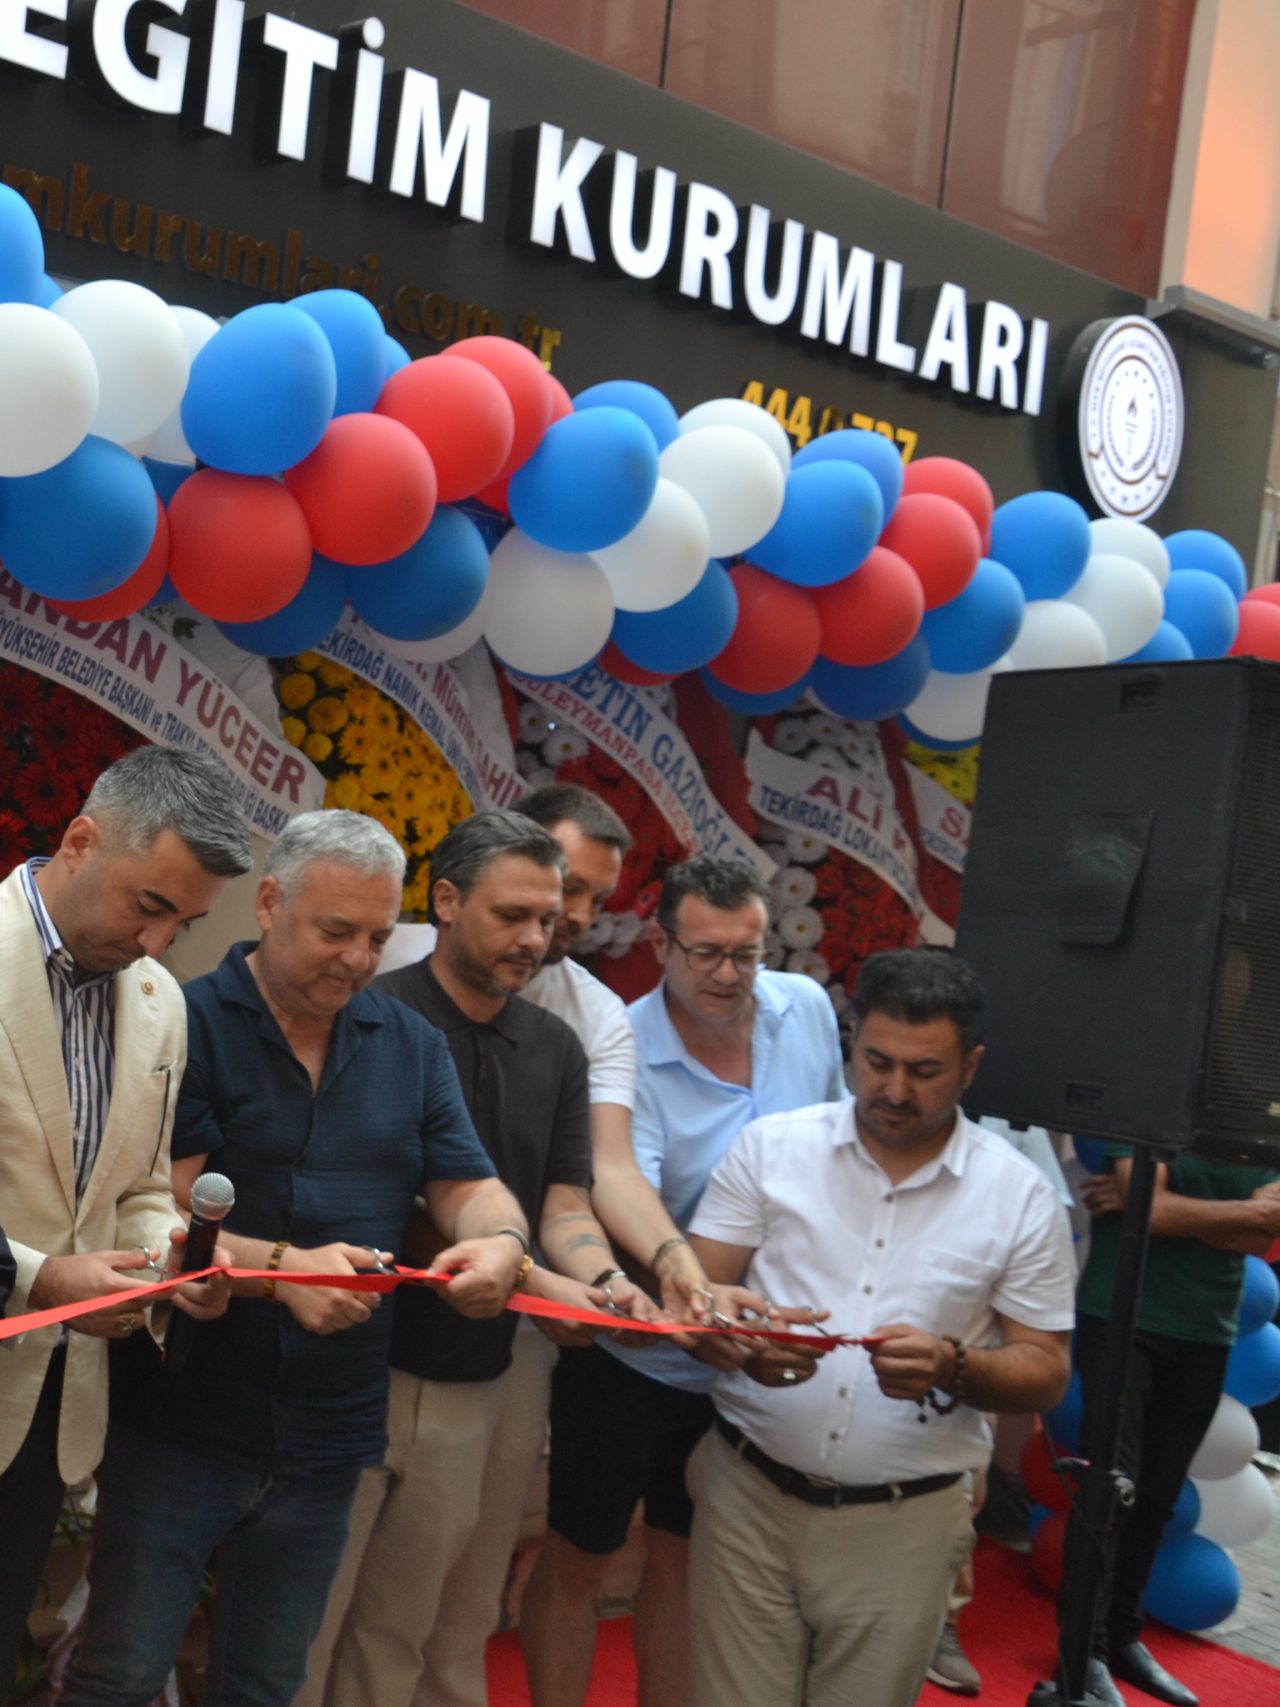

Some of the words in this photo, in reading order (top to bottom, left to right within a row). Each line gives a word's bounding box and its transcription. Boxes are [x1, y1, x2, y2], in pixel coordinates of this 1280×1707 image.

[530, 121, 1049, 416] KURUMLARI
[55, 645, 113, 697] BELEDİYE
[562, 664, 653, 744] ETİN
[175, 657, 306, 804] YÜCEER
